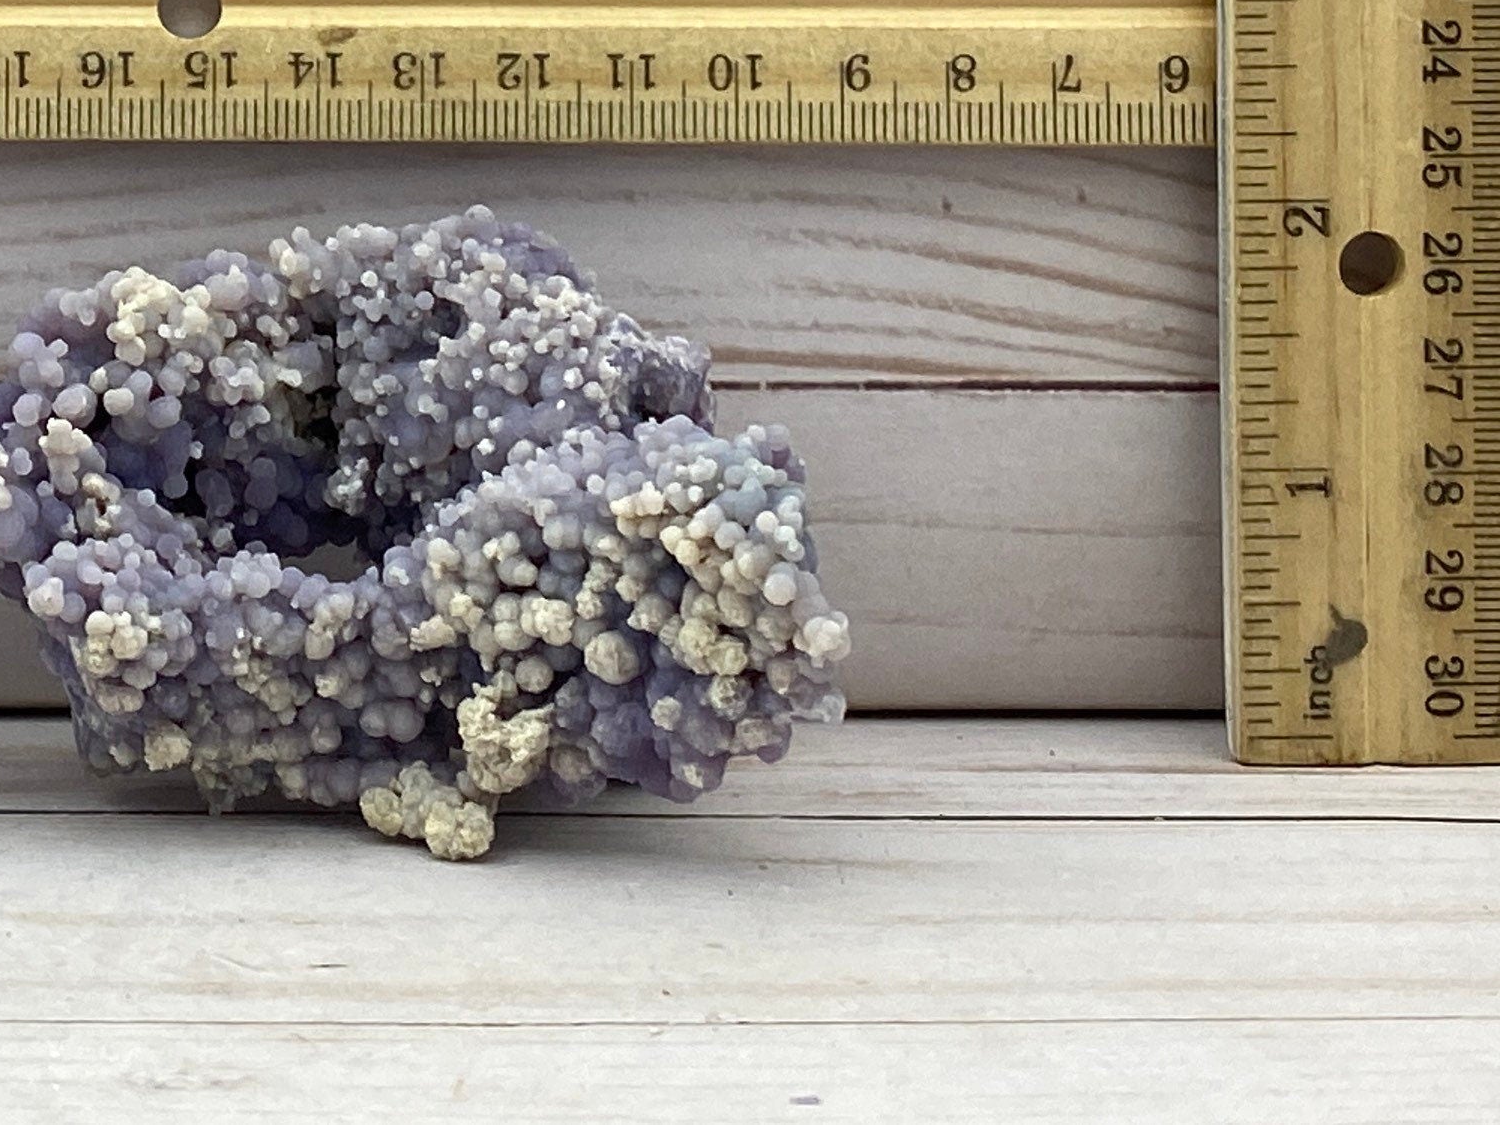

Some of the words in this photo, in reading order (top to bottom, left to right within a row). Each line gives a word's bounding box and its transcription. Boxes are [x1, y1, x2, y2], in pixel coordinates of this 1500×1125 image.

[80, 51, 134, 90] 16
[184, 51, 238, 90] 15
[288, 51, 343, 90] 14
[392, 52, 445, 91] 13
[497, 52, 550, 91] 12
[605, 52, 655, 91] 11
[708, 52, 763, 91] 10
[843, 52, 870, 91] 9
[1422, 20, 1464, 84] 24
[950, 53, 976, 92] 8
[1056, 53, 1082, 92] 7
[1163, 53, 1189, 92] 6
[1422, 127, 1464, 189] 25
[1283, 204, 1330, 239] 2
[1422, 232, 1464, 297] 26
[1422, 337, 1464, 402] 27
[1285, 475, 1329, 498] 1
[1422, 445, 1464, 506] 28
[1422, 550, 1464, 612] 29
[1304, 643, 1331, 722] inch
[1422, 655, 1464, 718] 30
